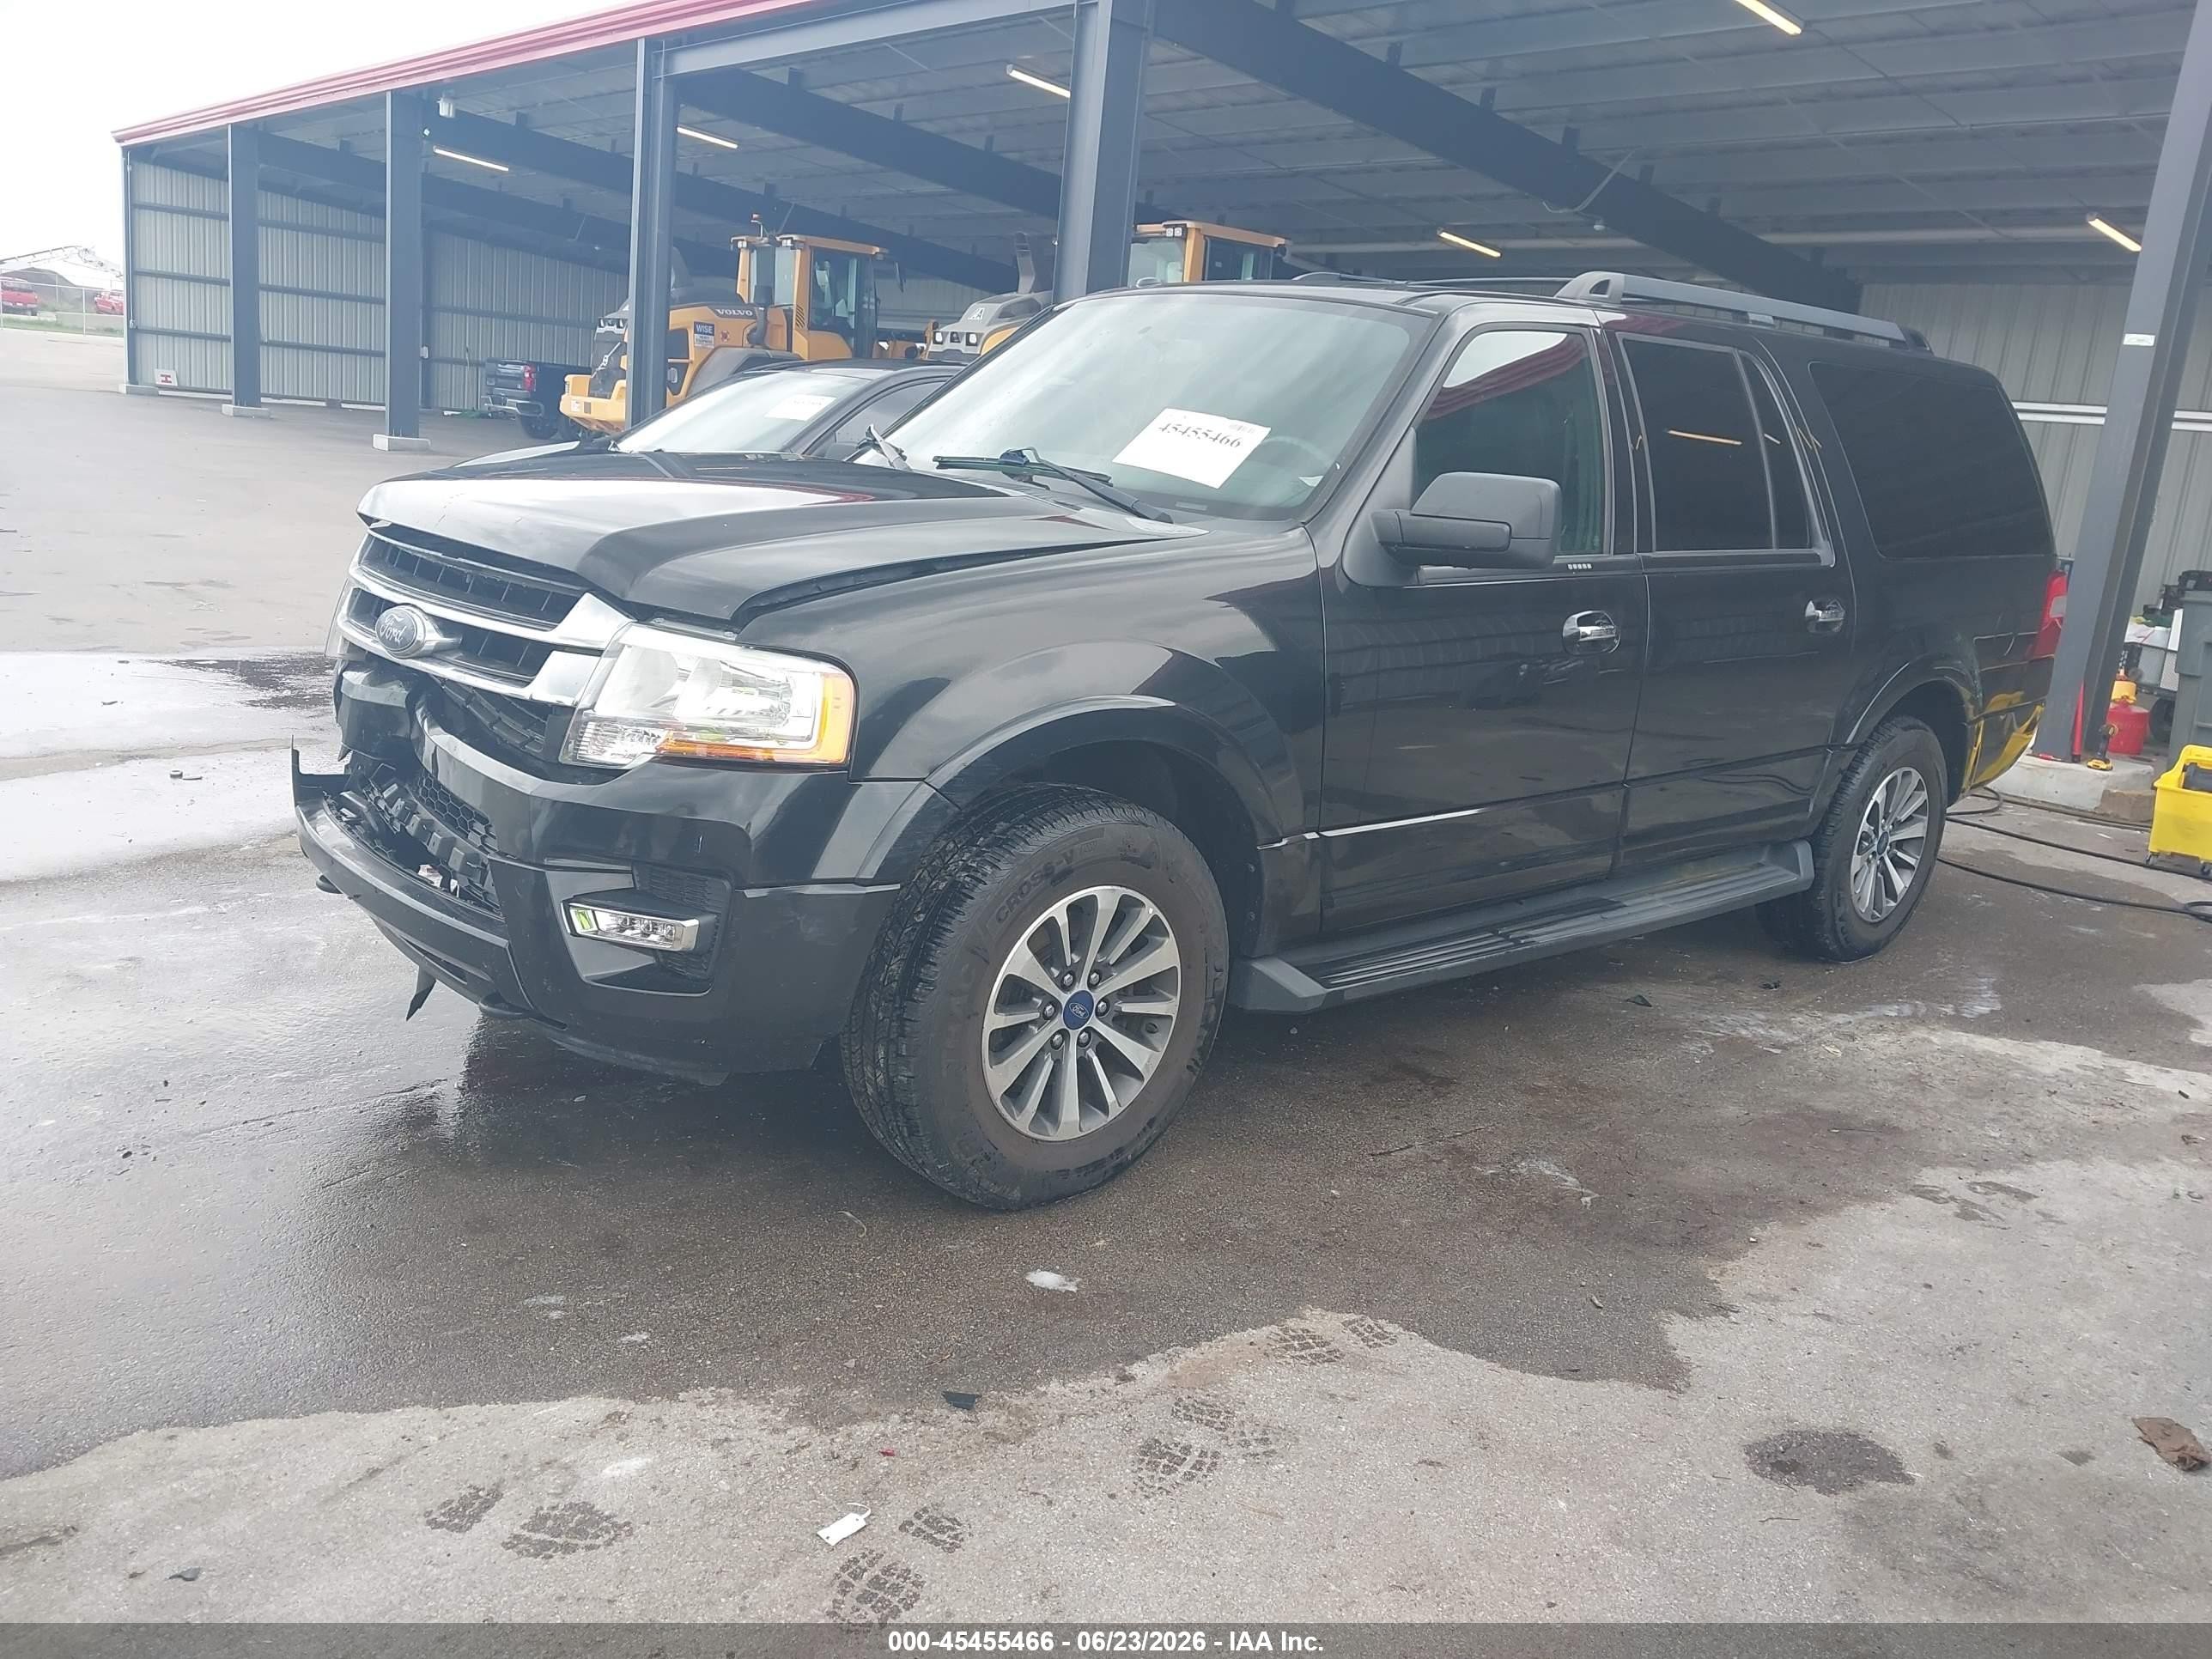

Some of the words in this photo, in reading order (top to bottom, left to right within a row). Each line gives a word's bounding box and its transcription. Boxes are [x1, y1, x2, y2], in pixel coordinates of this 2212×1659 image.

[715, 308, 753, 317] VOLVO
[696, 324, 714, 334] WISE
[1158, 423, 1242, 447] 45455466
[379, 614, 408, 645] Ford
